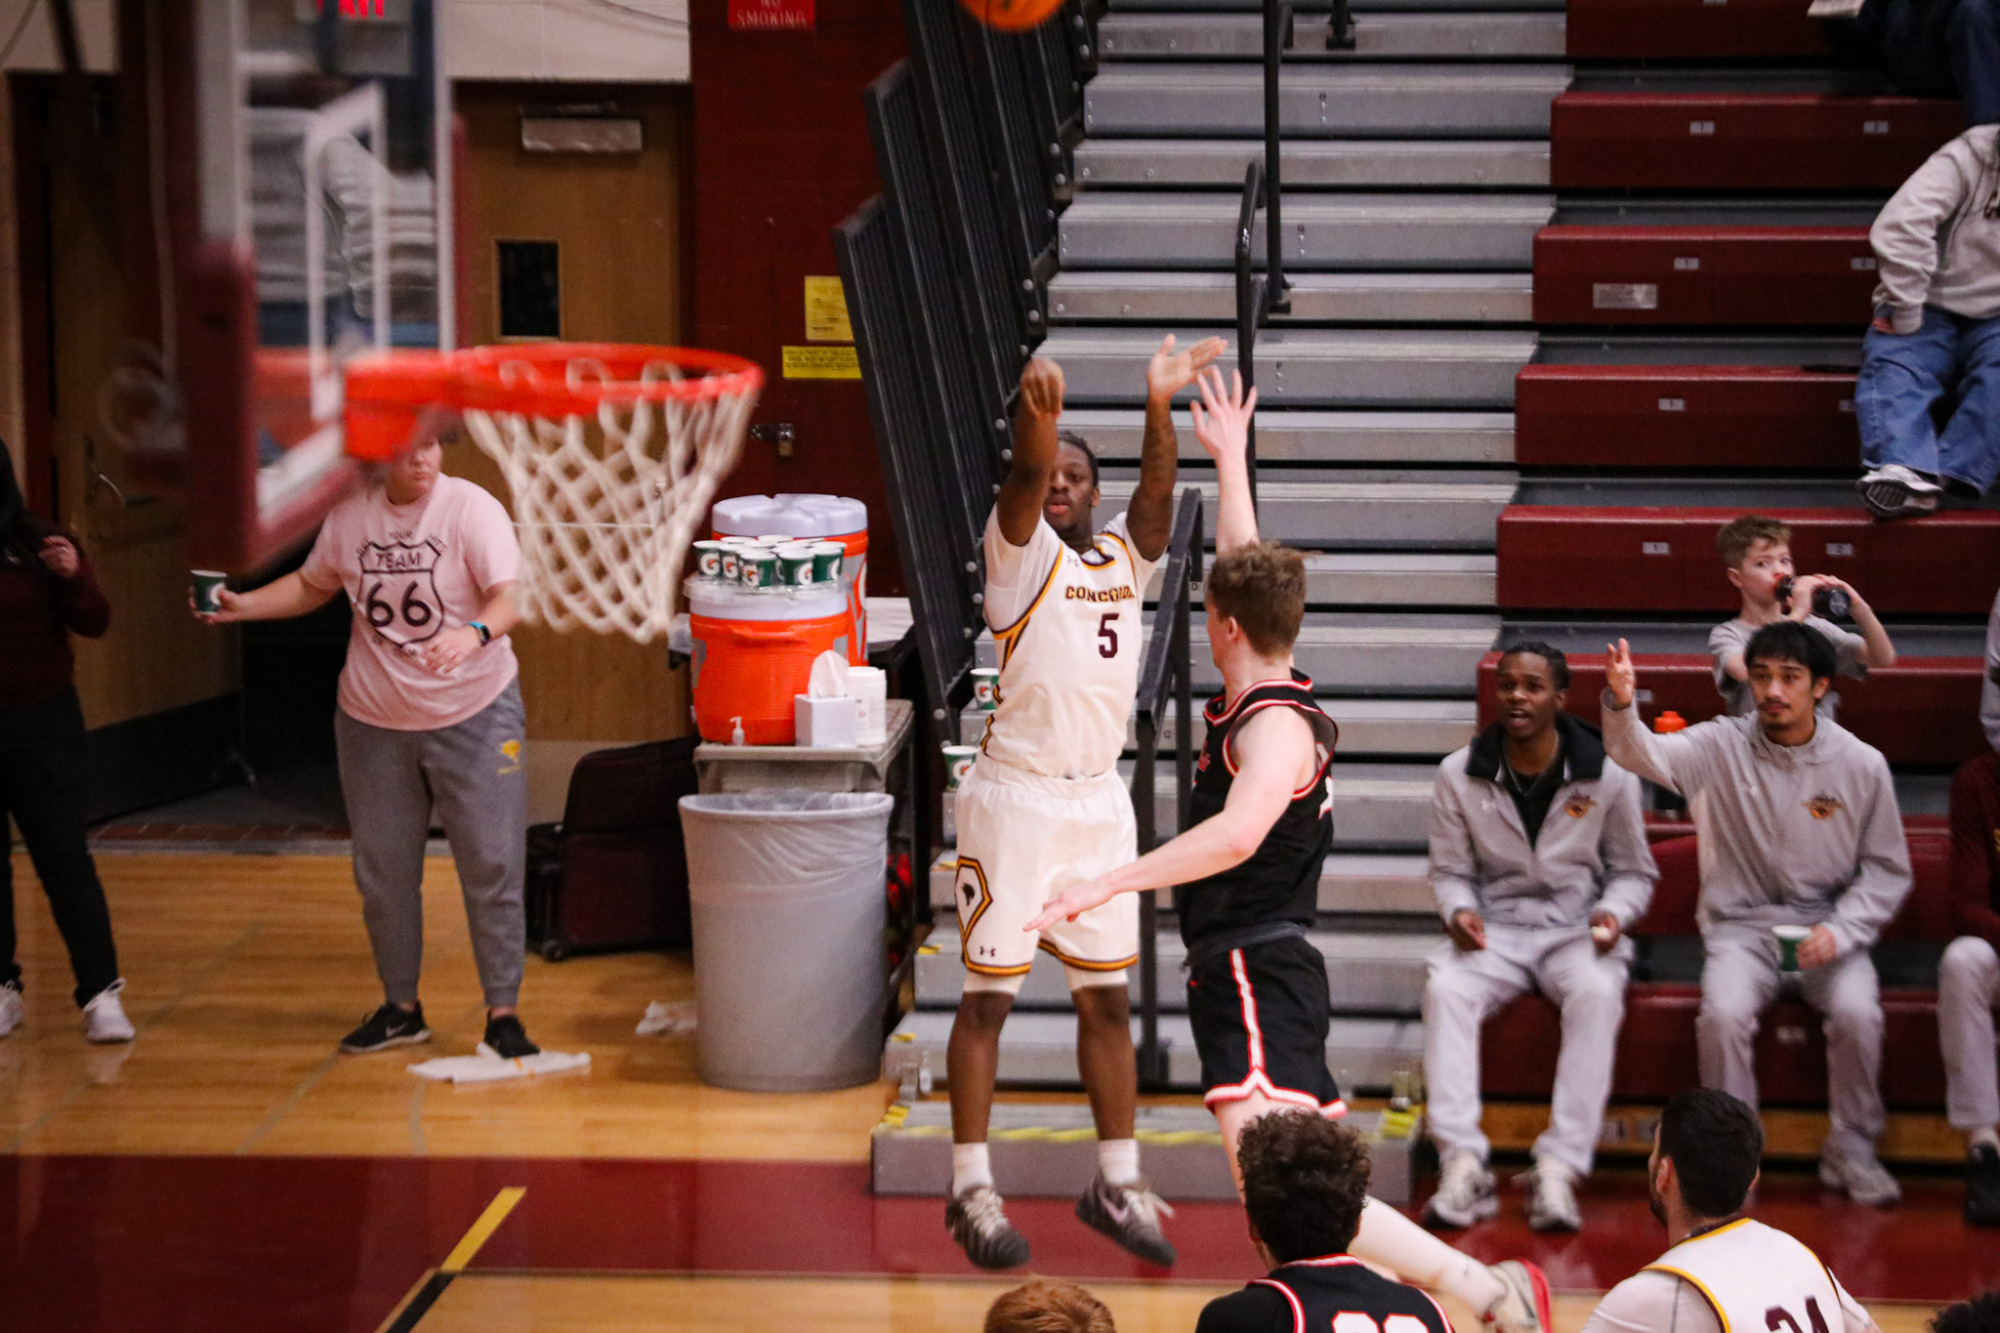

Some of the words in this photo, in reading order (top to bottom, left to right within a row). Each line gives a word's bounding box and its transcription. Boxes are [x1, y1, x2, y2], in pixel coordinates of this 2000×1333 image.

[736, 10, 806, 28] SMOKING
[375, 551, 420, 569] TEAM
[700, 552, 720, 576] G
[721, 555, 738, 579] G
[366, 580, 432, 628] 66
[1098, 612, 1120, 659] 5
[974, 680, 994, 703] G
